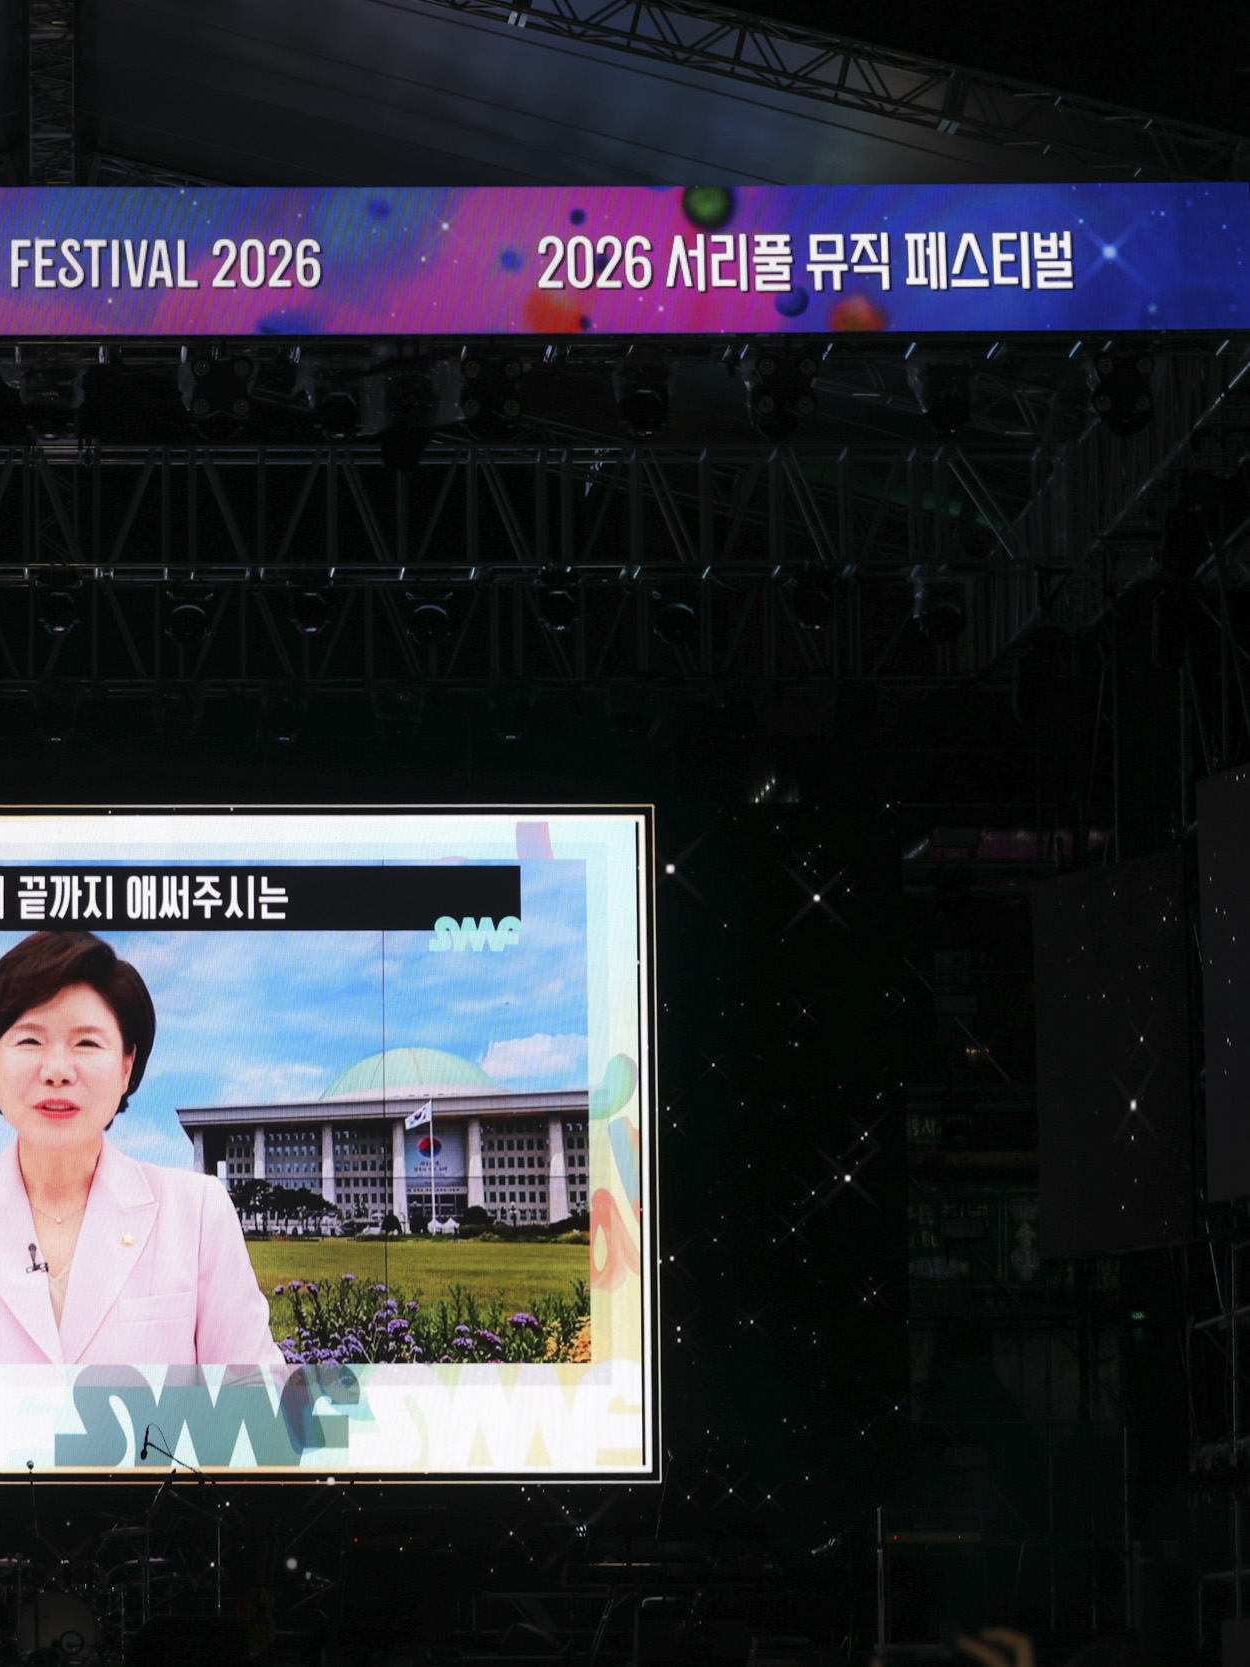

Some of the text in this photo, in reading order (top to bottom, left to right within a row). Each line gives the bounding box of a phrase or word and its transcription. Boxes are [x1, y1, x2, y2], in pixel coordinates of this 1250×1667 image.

[10, 237, 199, 289] FESTIVAL
[212, 238, 321, 288] 2026
[537, 231, 1075, 292] 2026 서리풀 뮤직 페스티벌
[17, 875, 113, 920] 끝까지
[126, 875, 289, 920] 애써주시는
